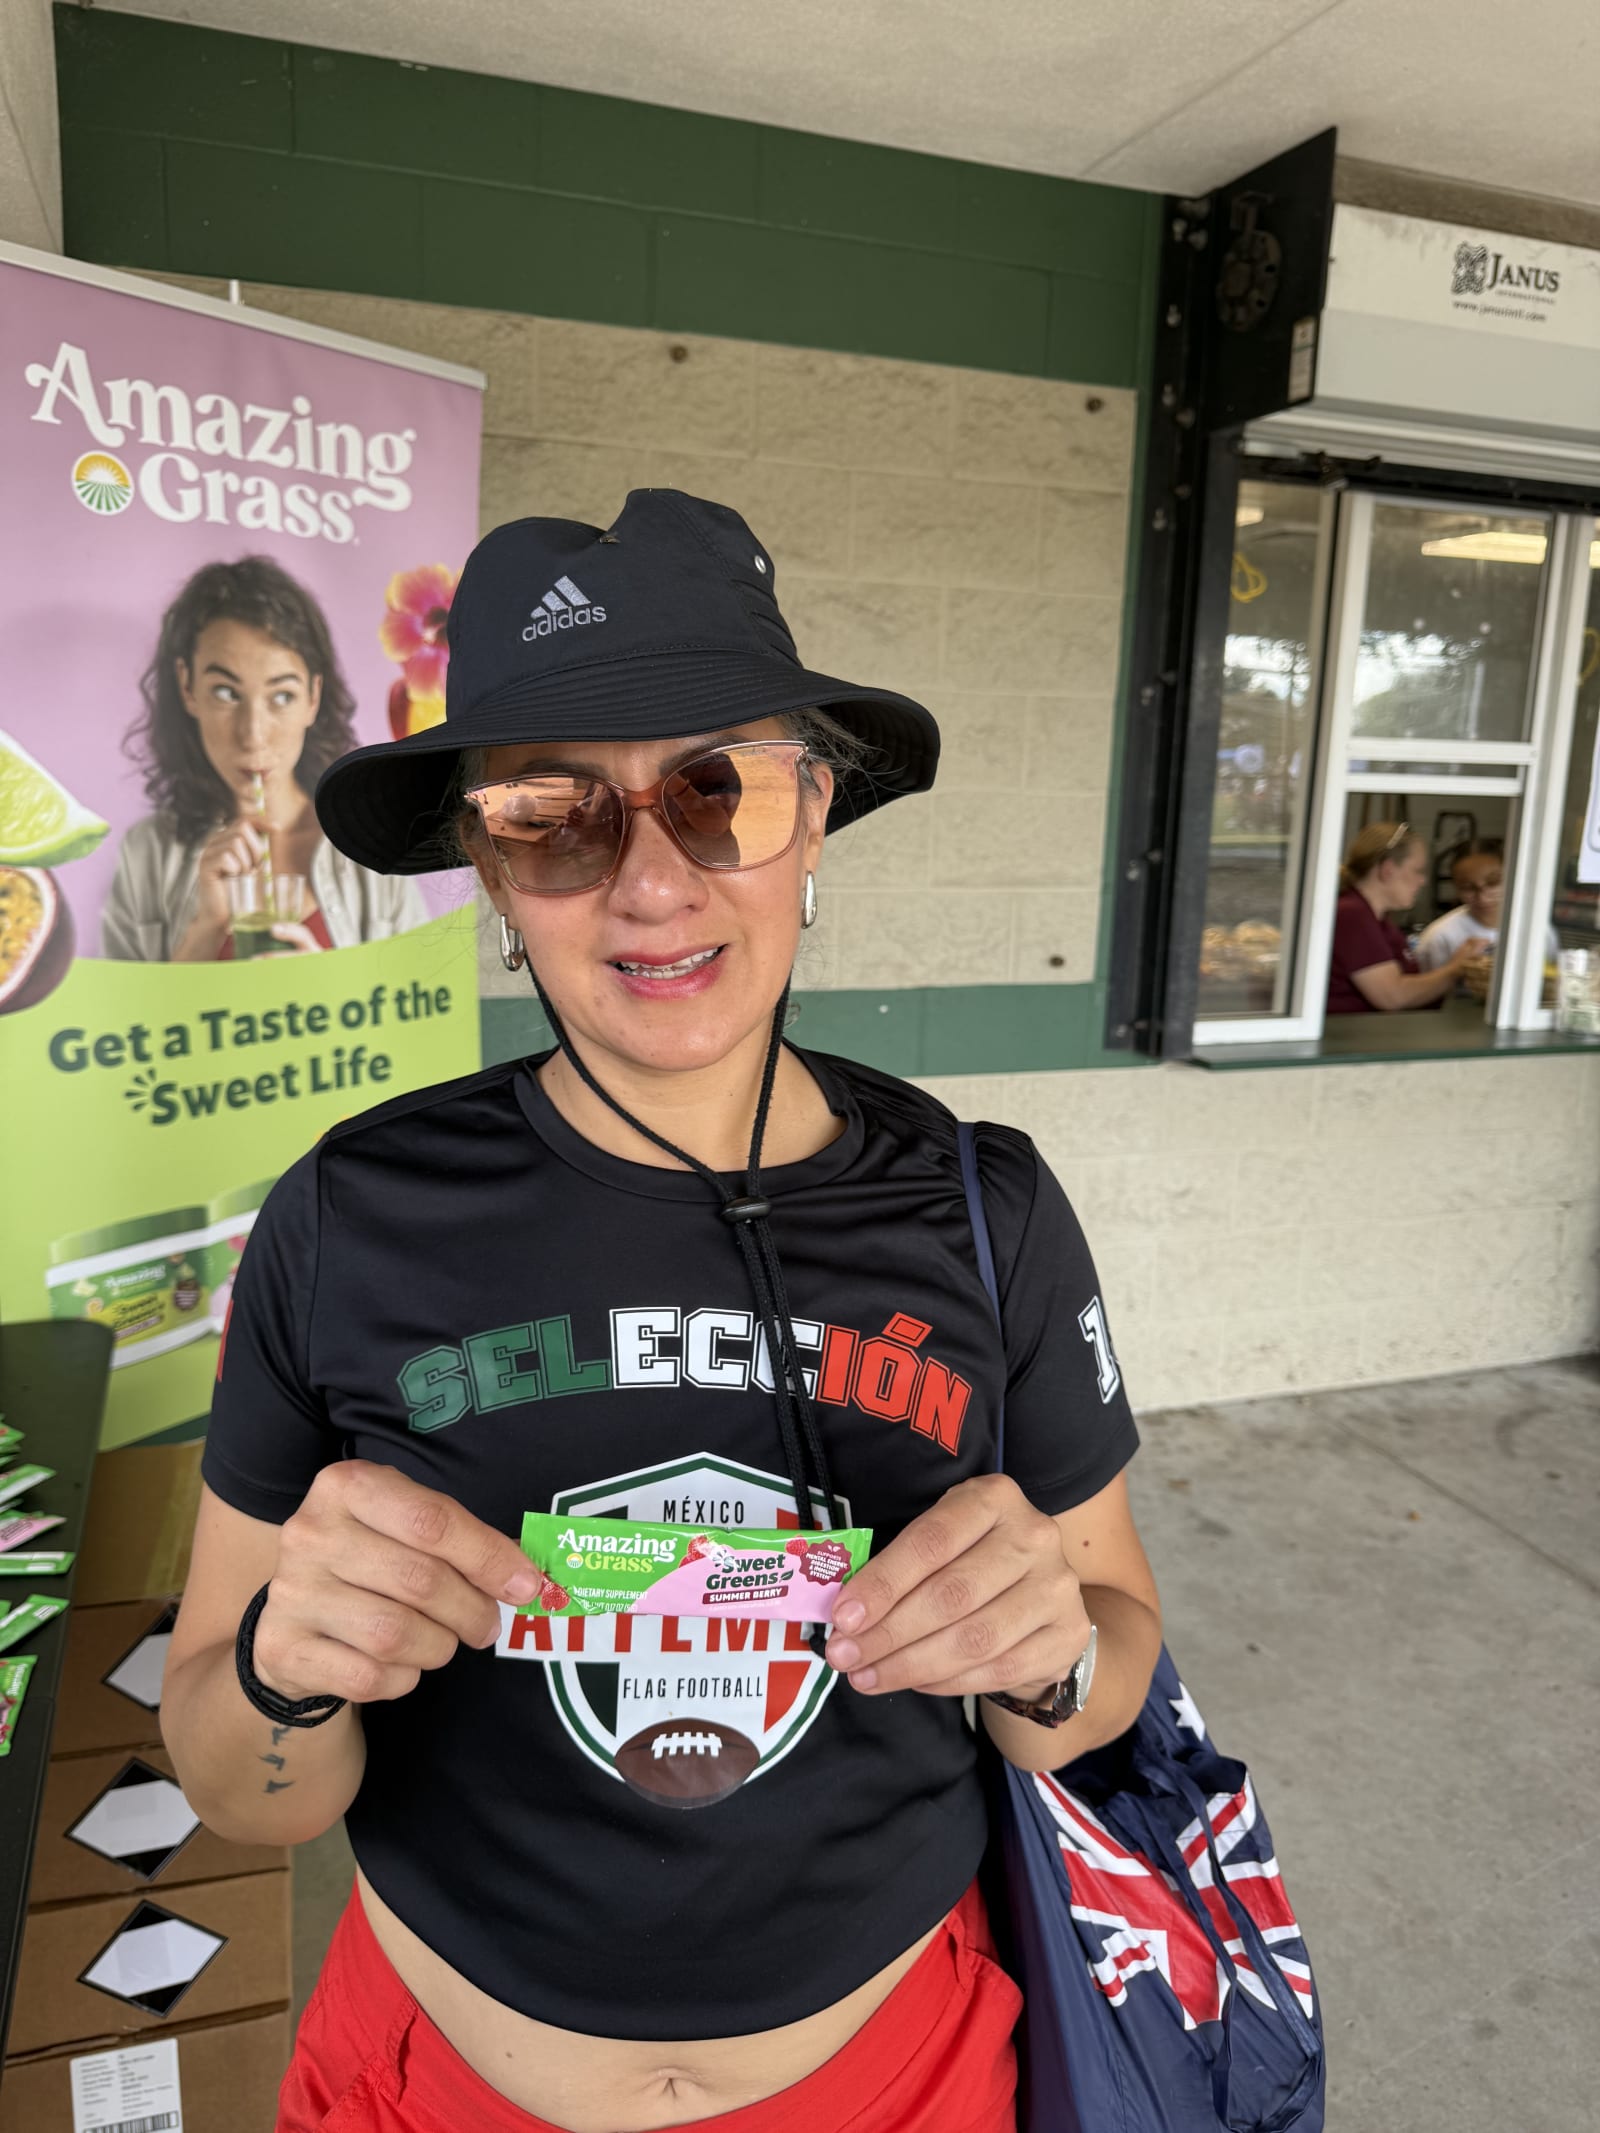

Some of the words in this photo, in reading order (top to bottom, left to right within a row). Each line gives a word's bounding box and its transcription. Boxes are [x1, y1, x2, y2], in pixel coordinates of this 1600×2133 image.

[1487, 253, 1561, 293] JANUS
[25, 342, 416, 511] Amazing
[139, 452, 355, 544] Grass
[522, 606, 607, 641] adidas
[49, 1023, 153, 1073] Get
[163, 1029, 192, 1058] a
[201, 1001, 331, 1053] Taste
[339, 985, 388, 1030] of
[394, 980, 453, 1022] the
[150, 1067, 302, 1126] Sweet
[310, 1045, 393, 1095] Life
[396, 1306, 972, 1456] SELECCIÓN
[663, 1496, 744, 1523] MÉXICO
[557, 1528, 678, 1563] Amazing
[805, 1552, 827, 1562] MENTAL
[584, 1551, 654, 1574] Grass
[721, 1553, 786, 1574] Sweet
[810, 1560, 840, 1572] DIGESTION
[578, 1587, 605, 1598] DIETARY
[605, 1589, 649, 1600] SUPPLEMENT
[706, 1572, 778, 1591] Greens
[709, 1591, 751, 1602] SUMMER
[752, 1588, 783, 1600] BERRY
[623, 1678, 667, 1699] FLAG
[677, 1676, 764, 1699] FOOTBALL
